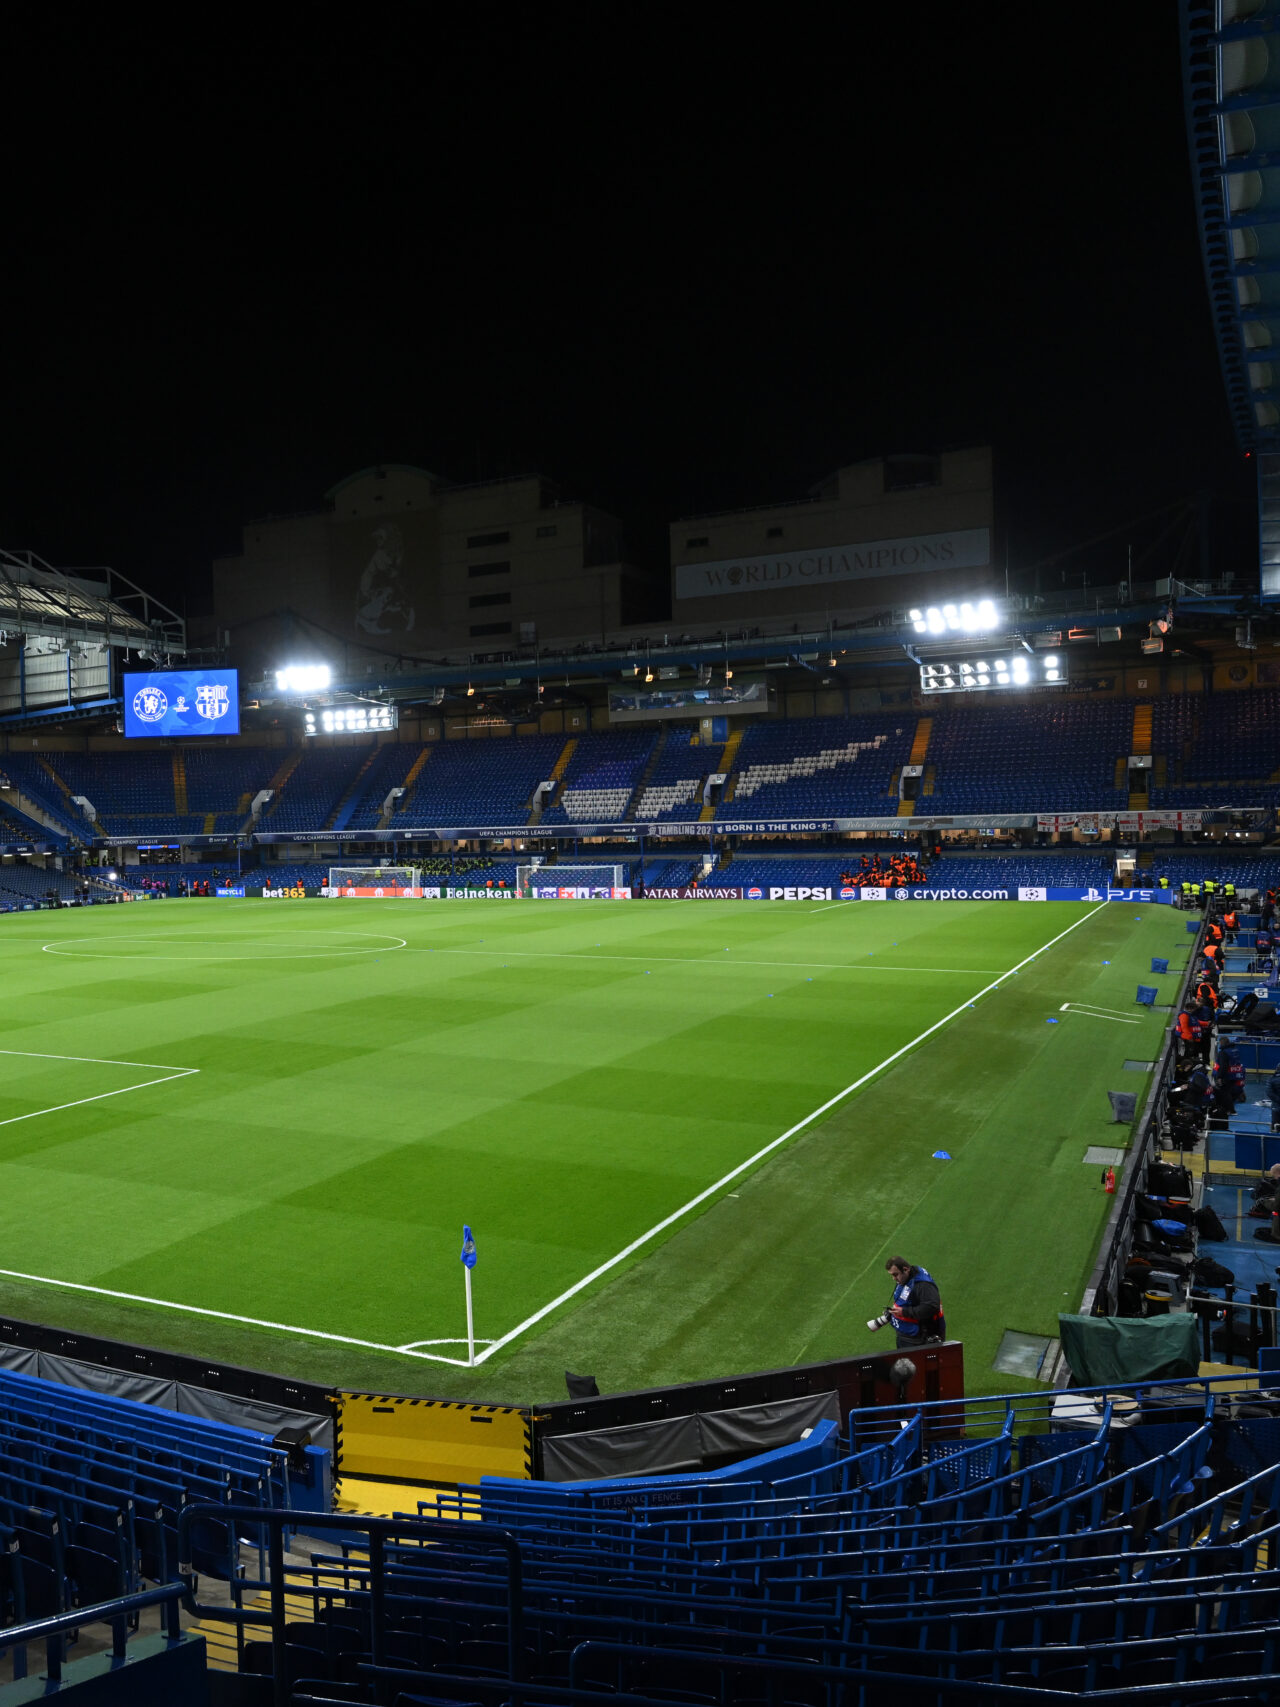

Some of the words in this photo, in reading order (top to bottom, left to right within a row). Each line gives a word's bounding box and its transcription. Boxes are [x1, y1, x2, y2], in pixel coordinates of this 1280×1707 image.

[798, 541, 955, 577] CHAMPIONS
[658, 824, 695, 835] TAMBLING
[724, 822, 753, 832] BORN
[755, 823, 765, 831] IS
[767, 822, 788, 831] THE
[790, 822, 816, 830] KING
[262, 887, 306, 898] bet365
[446, 887, 512, 899] Heineken
[537, 887, 574, 899] FedEx
[684, 888, 737, 899] AIRWAYS
[770, 887, 832, 900] PEPSI
[914, 888, 1008, 900] crypto.com
[1109, 890, 1154, 901] PS5
